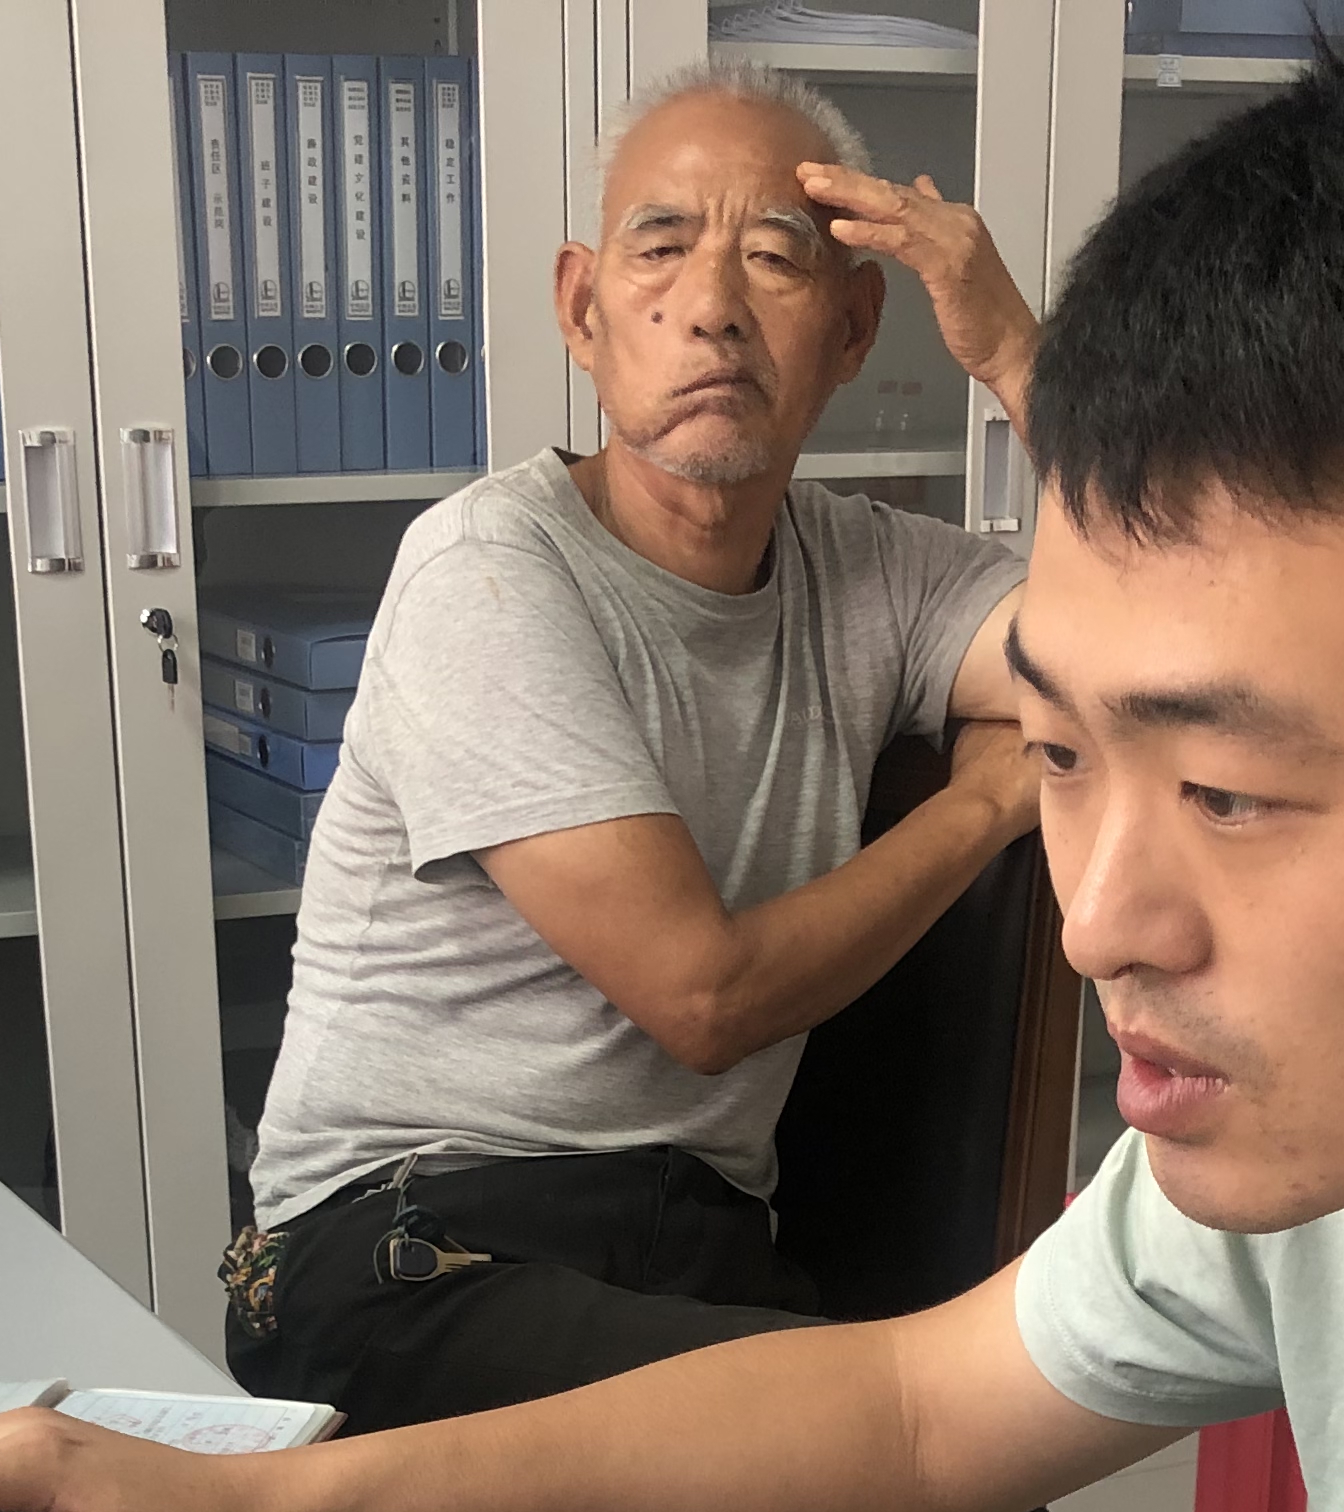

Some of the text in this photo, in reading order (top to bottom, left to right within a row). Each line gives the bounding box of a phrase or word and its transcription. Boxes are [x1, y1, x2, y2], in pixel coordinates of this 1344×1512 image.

[353, 134, 367, 241] 党建文化建设
[399, 136, 412, 204] 其他资料
[444, 138, 457, 204] 稳定工作
